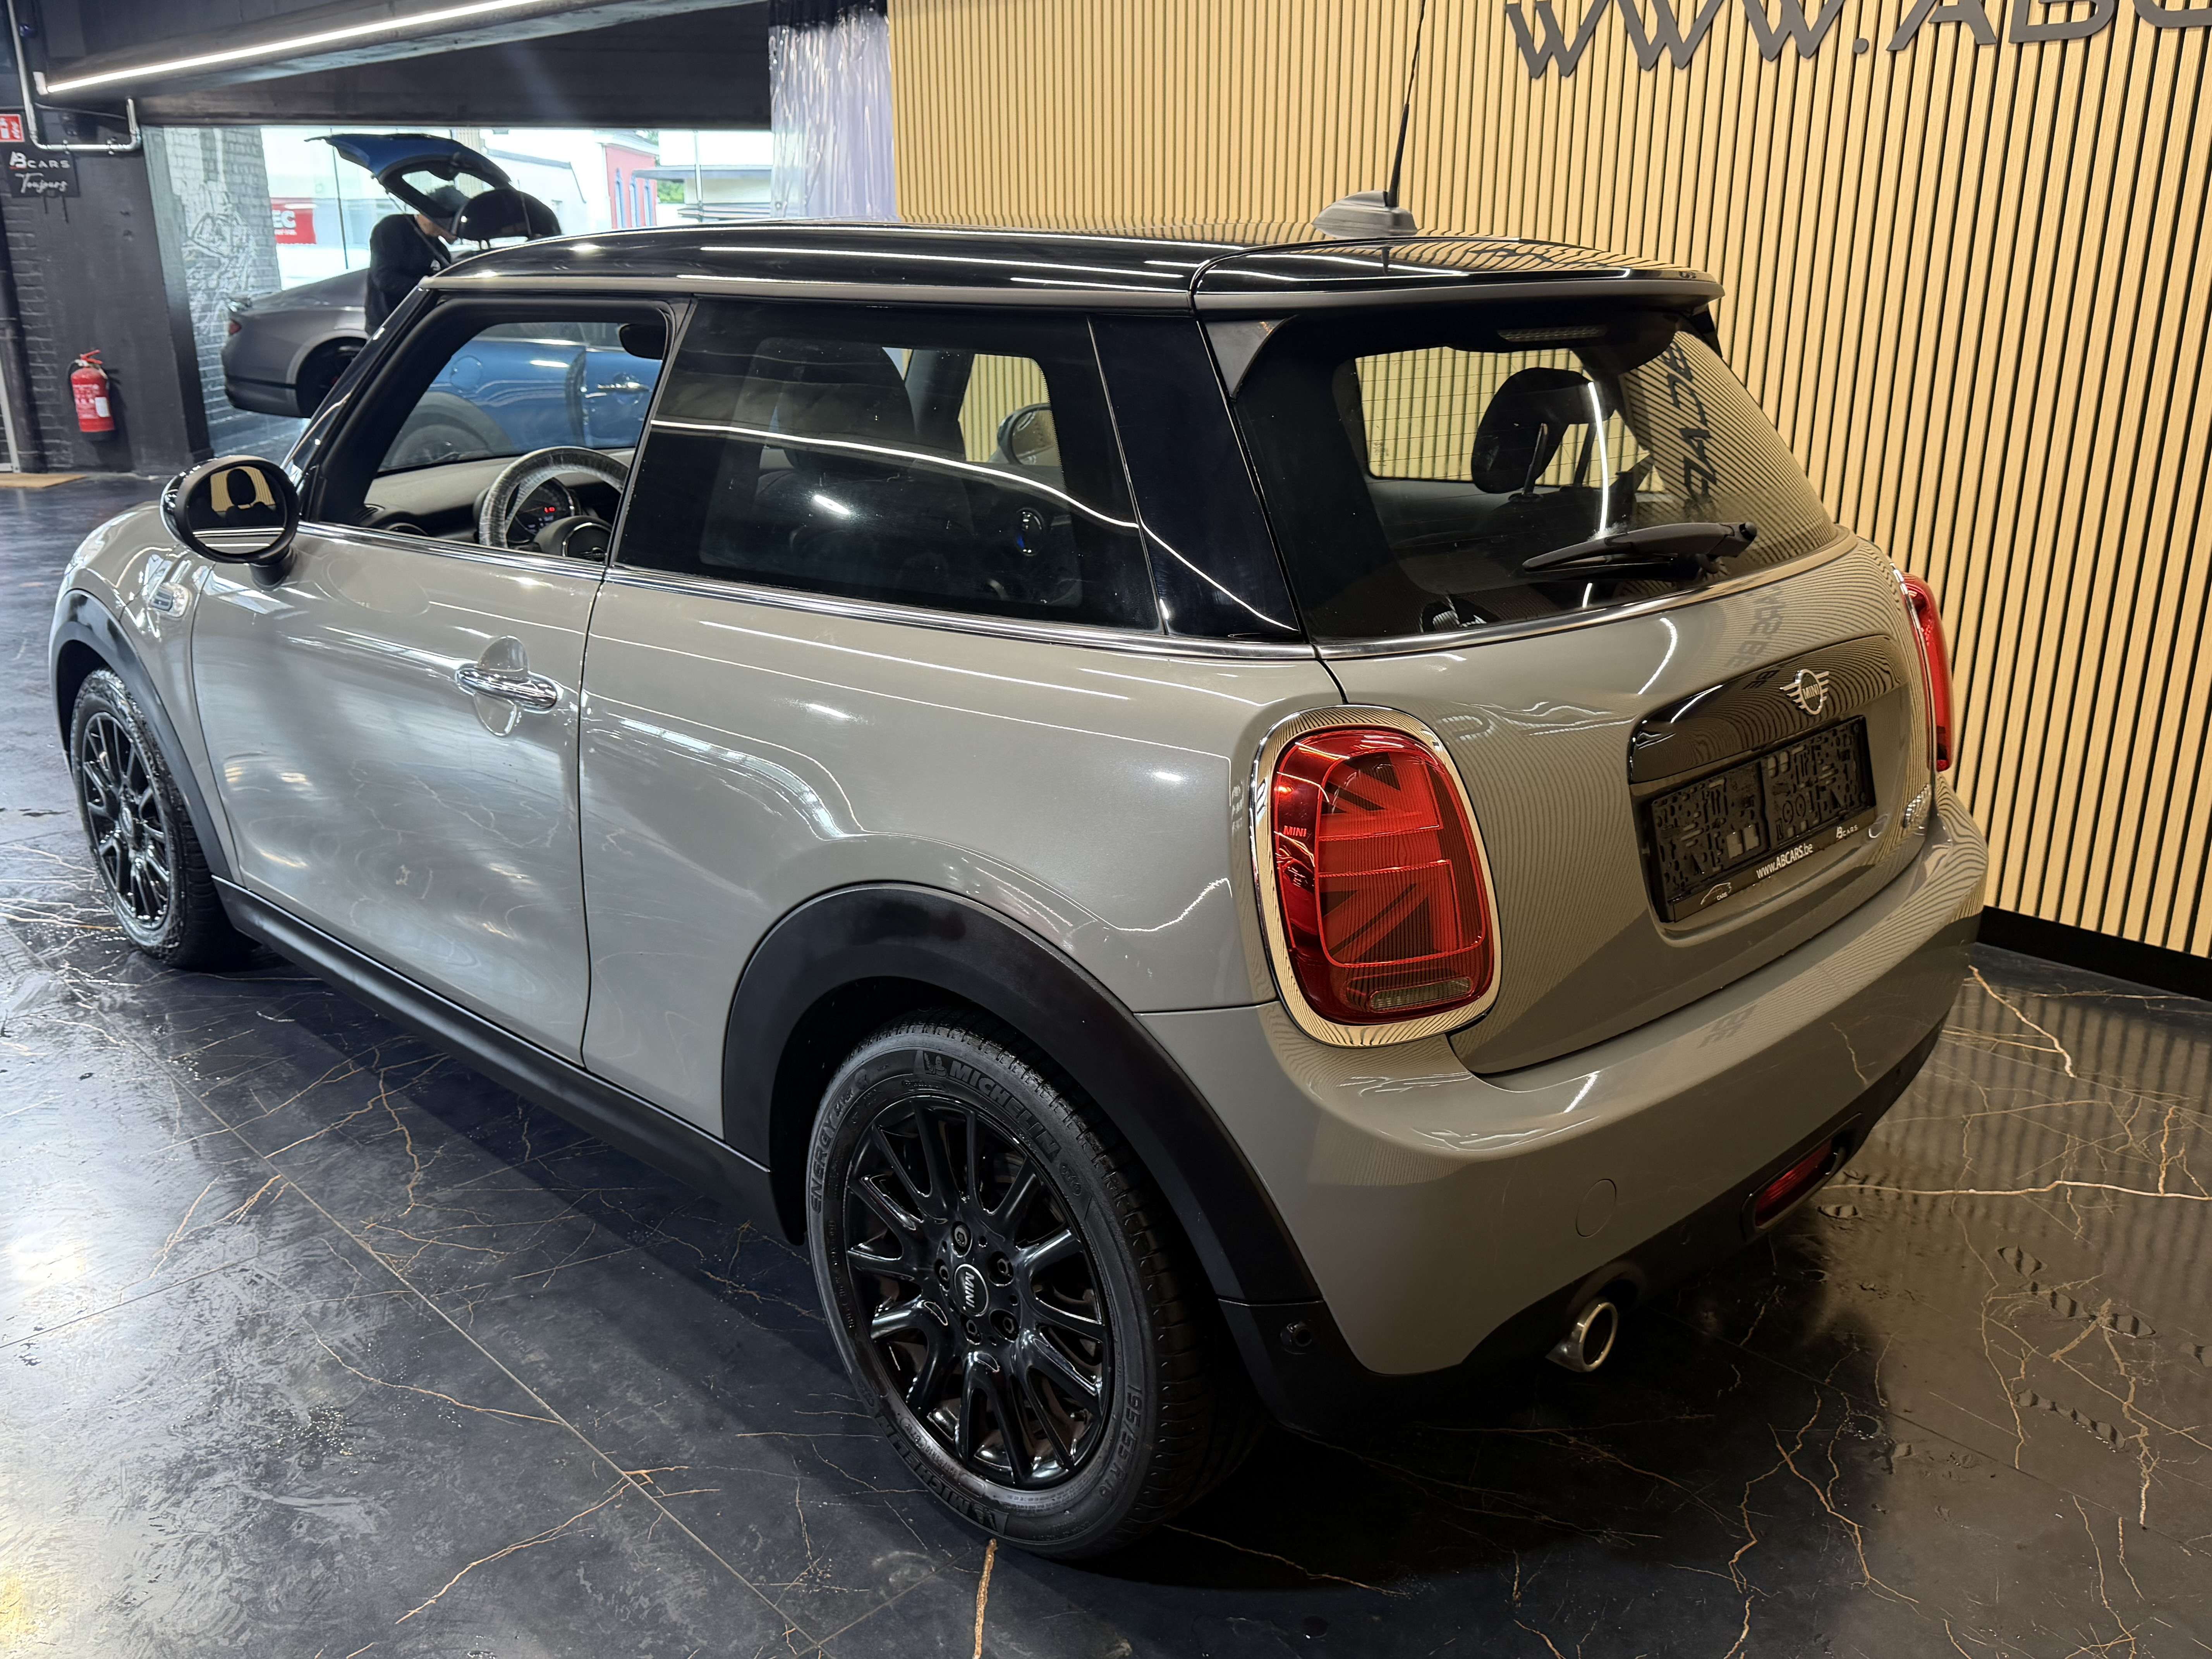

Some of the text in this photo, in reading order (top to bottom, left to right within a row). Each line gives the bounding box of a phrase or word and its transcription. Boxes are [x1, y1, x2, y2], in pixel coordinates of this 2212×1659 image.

[1802, 683, 1821, 700] MINI
[1283, 825, 1307, 837] MINI
[1756, 843, 1814, 879] www.ABCARS.be
[948, 1060, 1062, 1159] MICHELIN
[965, 1271, 975, 1308] MINI
